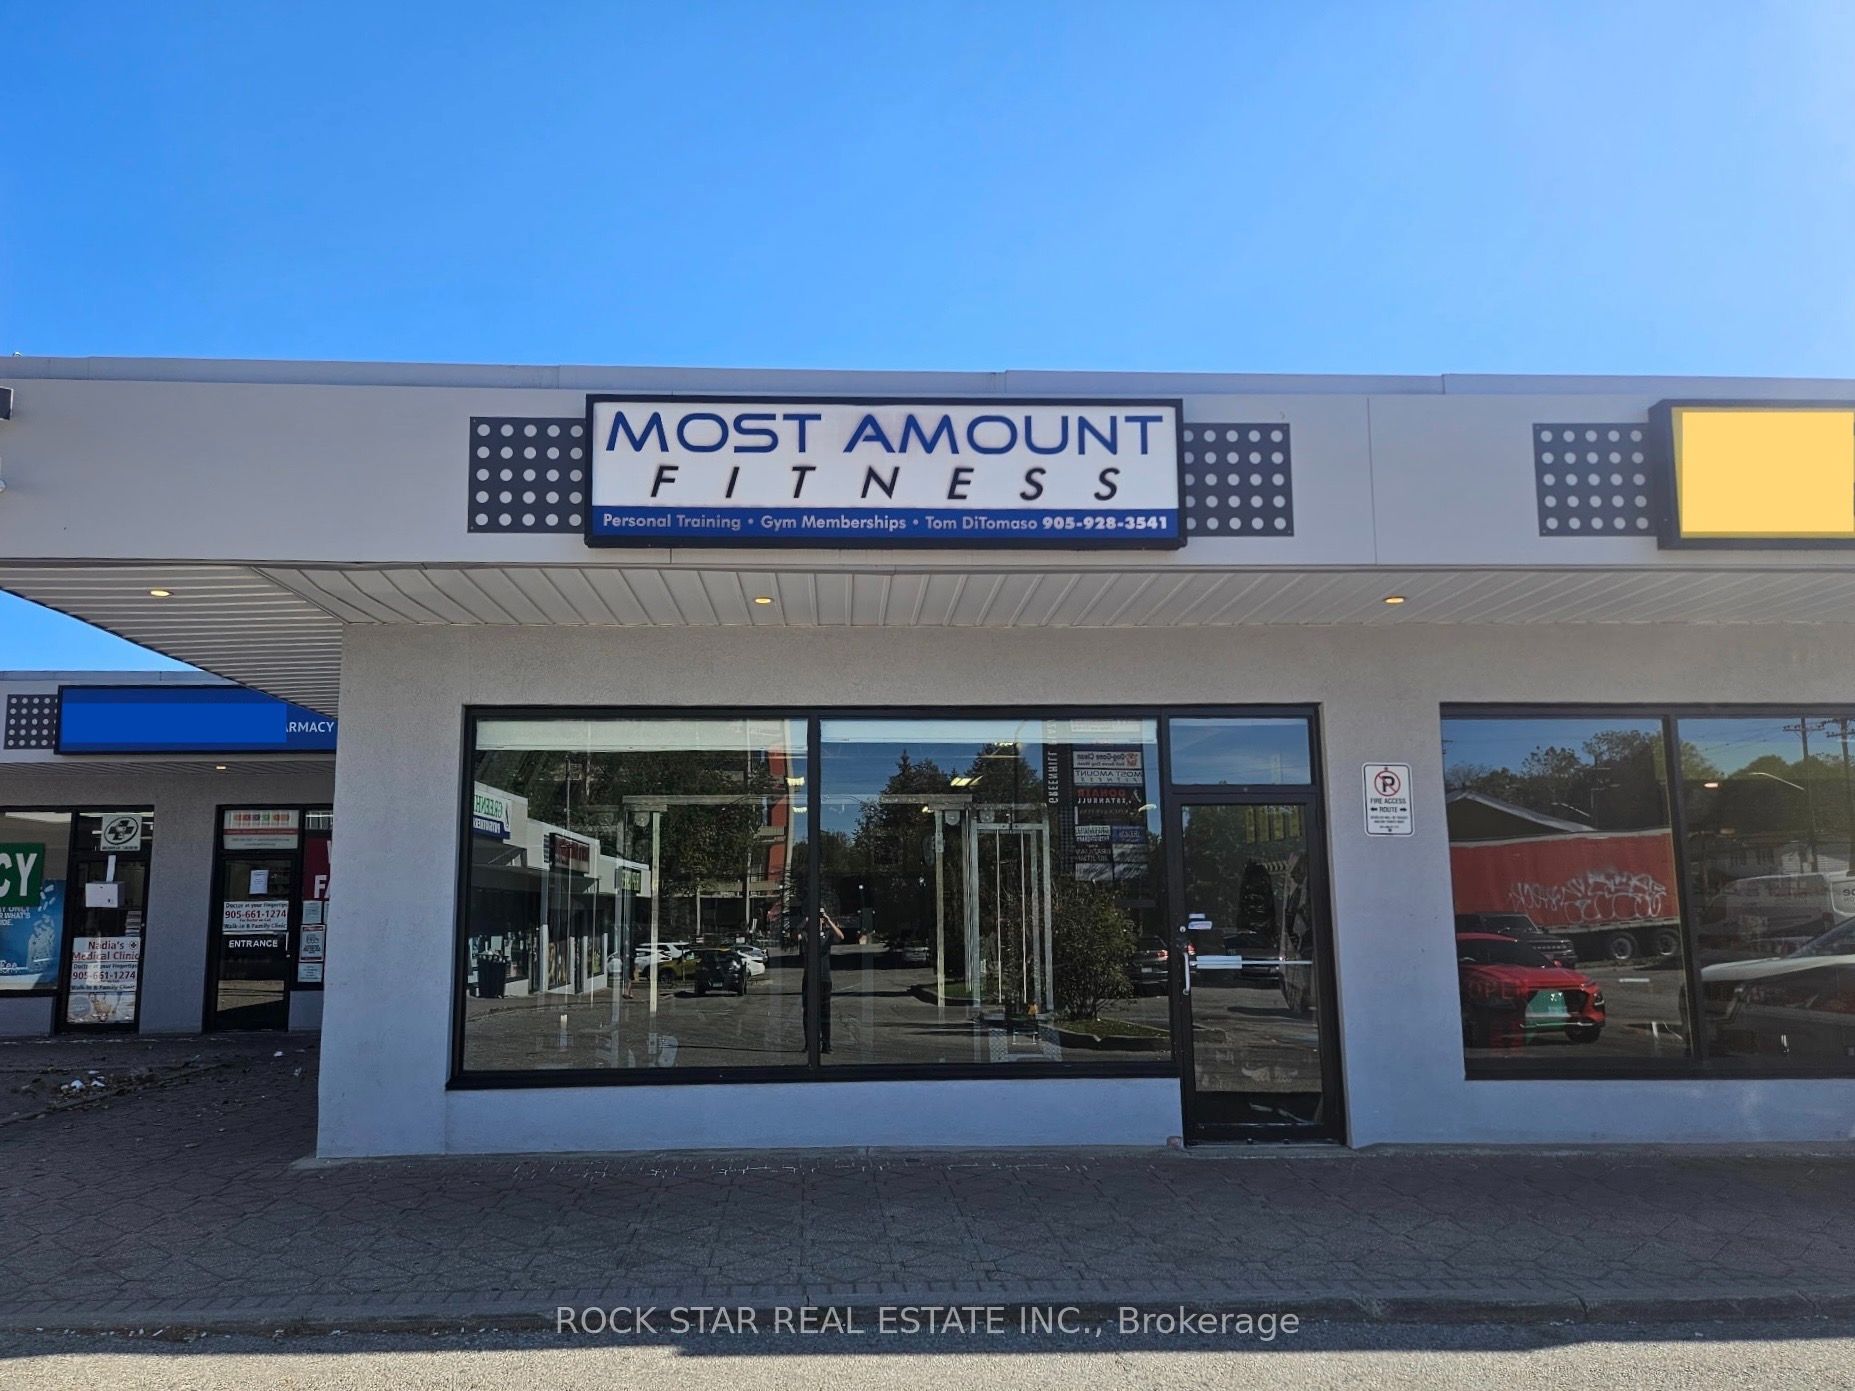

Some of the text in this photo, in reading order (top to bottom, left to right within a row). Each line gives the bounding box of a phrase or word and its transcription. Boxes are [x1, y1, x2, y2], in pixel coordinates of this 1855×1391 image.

[606, 411, 1163, 455] MOST AMOUNT
[651, 466, 1120, 501] FITNESS
[603, 513, 1167, 532] Personal Training Gym Memberships Tom DiTomaso 905-928-3541
[286, 721, 335, 733] RMACY
[225, 910, 287, 918] 905-661-1274
[88, 940, 125, 949] Nadia's
[228, 939, 278, 948] ENTRANCE
[113, 951, 140, 960] Clinic
[73, 971, 135, 980] 905-661-1274
